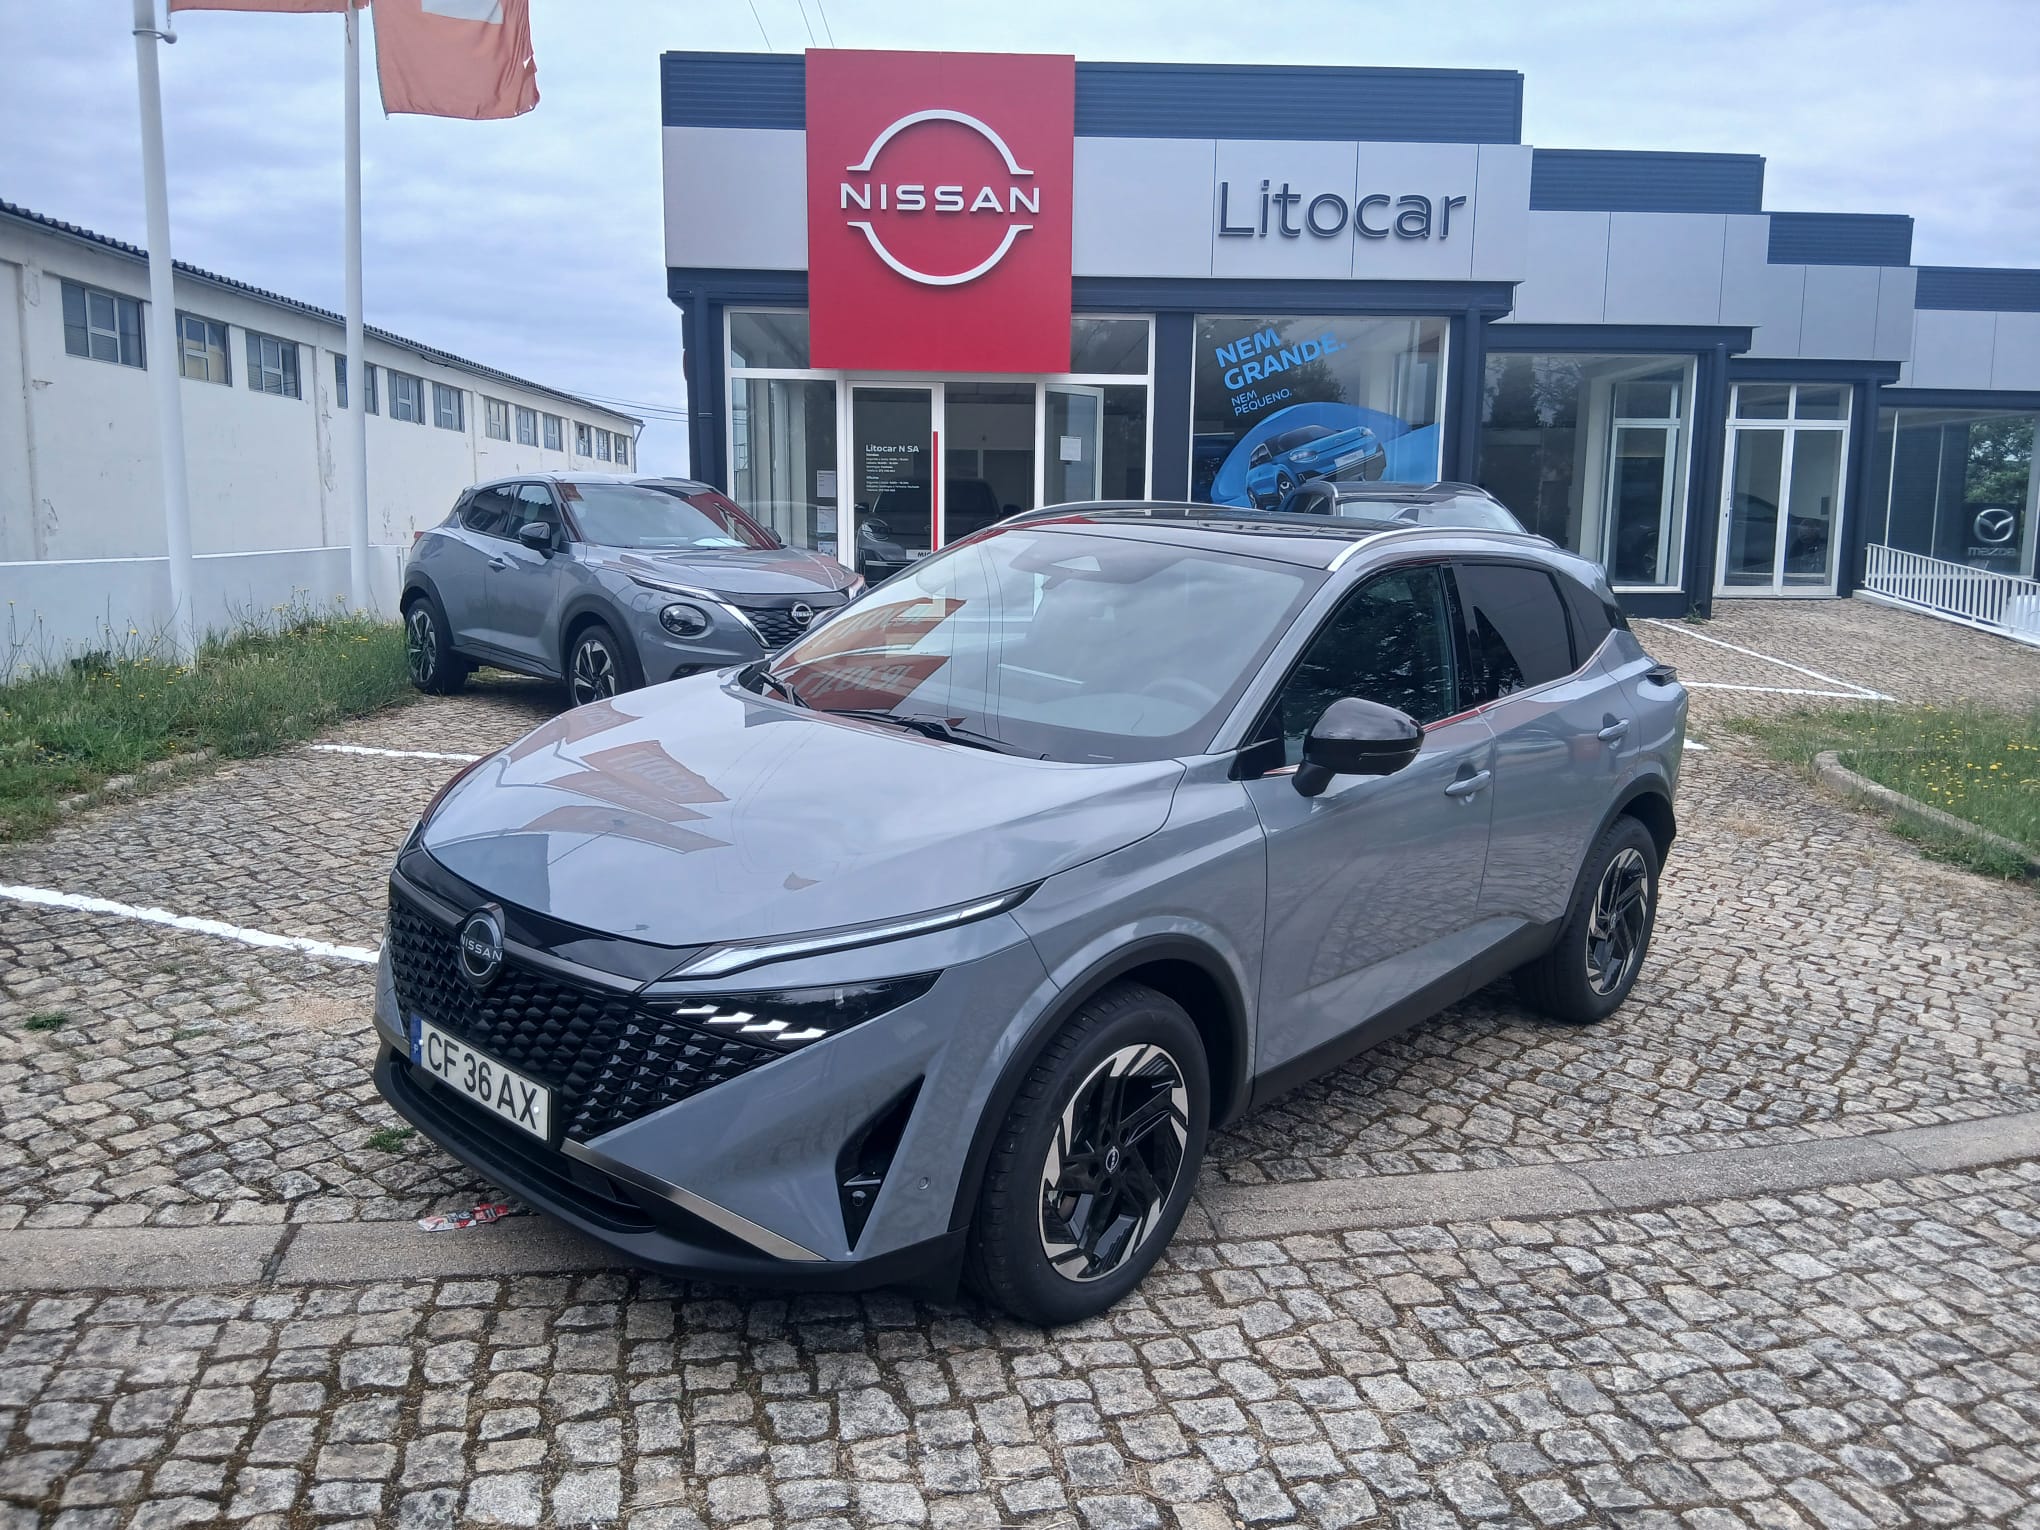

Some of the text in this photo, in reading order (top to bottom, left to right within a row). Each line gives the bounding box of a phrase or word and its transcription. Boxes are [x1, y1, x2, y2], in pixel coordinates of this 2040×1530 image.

[840, 182, 1040, 214] NISSAN
[1218, 179, 1467, 240] Litocar
[1215, 327, 1281, 368] NEM
[1224, 331, 1348, 391] GRANDE.
[1231, 389, 1258, 407] NEM
[1234, 388, 1293, 417] PEQUENO.
[865, 443, 920, 453] Litocar N SA
[459, 933, 503, 961] NISSAN
[427, 1032, 538, 1130] CF 36 AX
